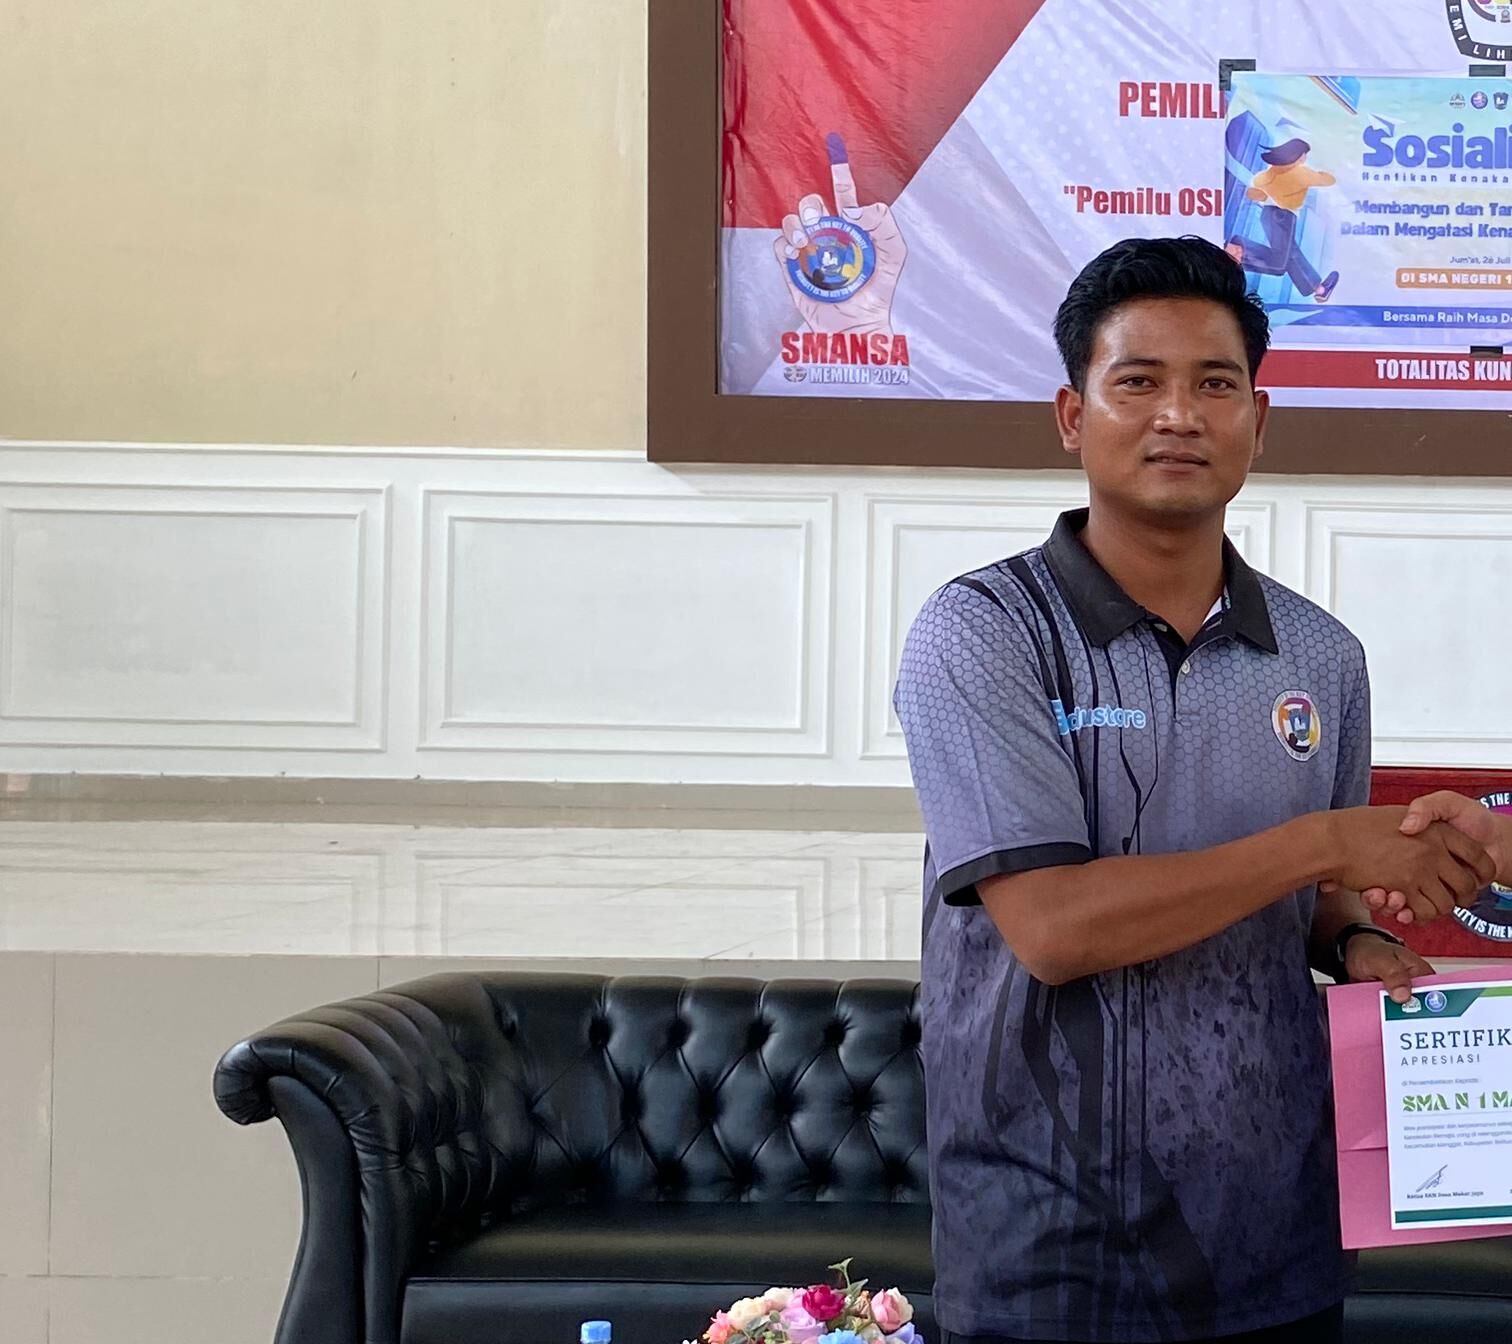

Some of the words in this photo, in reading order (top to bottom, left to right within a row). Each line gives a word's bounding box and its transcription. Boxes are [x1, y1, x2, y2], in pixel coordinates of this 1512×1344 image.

[1362, 172, 1438, 182] Hentikan
[1063, 185, 1171, 215] "Pemilu
[1178, 187, 1222, 217] OSI
[1455, 201, 1484, 216] dan
[1341, 221, 1390, 236] Dalam
[1394, 222, 1473, 240] Mengatasi
[1401, 272, 1415, 283] DI
[1419, 272, 1449, 284] SMA
[1452, 273, 1501, 285] NEGERI
[1506, 273, 1512, 285] 1
[1383, 310, 1435, 323] Bersama
[1437, 311, 1464, 323] Raih
[1467, 312, 1498, 324] Masa
[781, 331, 910, 367] SMANSA
[810, 366, 870, 384] MEMILIH
[873, 367, 910, 385] 2024
[1375, 359, 1470, 381] TOTALITAS
[1489, 792, 1510, 807] THE
[1474, 919, 1487, 933] IS
[1487, 923, 1507, 938] THE
[1400, 1053, 1481, 1067] APRESIASI
[1402, 1093, 1450, 1112] SMA
[1455, 1092, 1469, 1110] N
[1478, 1092, 1486, 1109] 1
